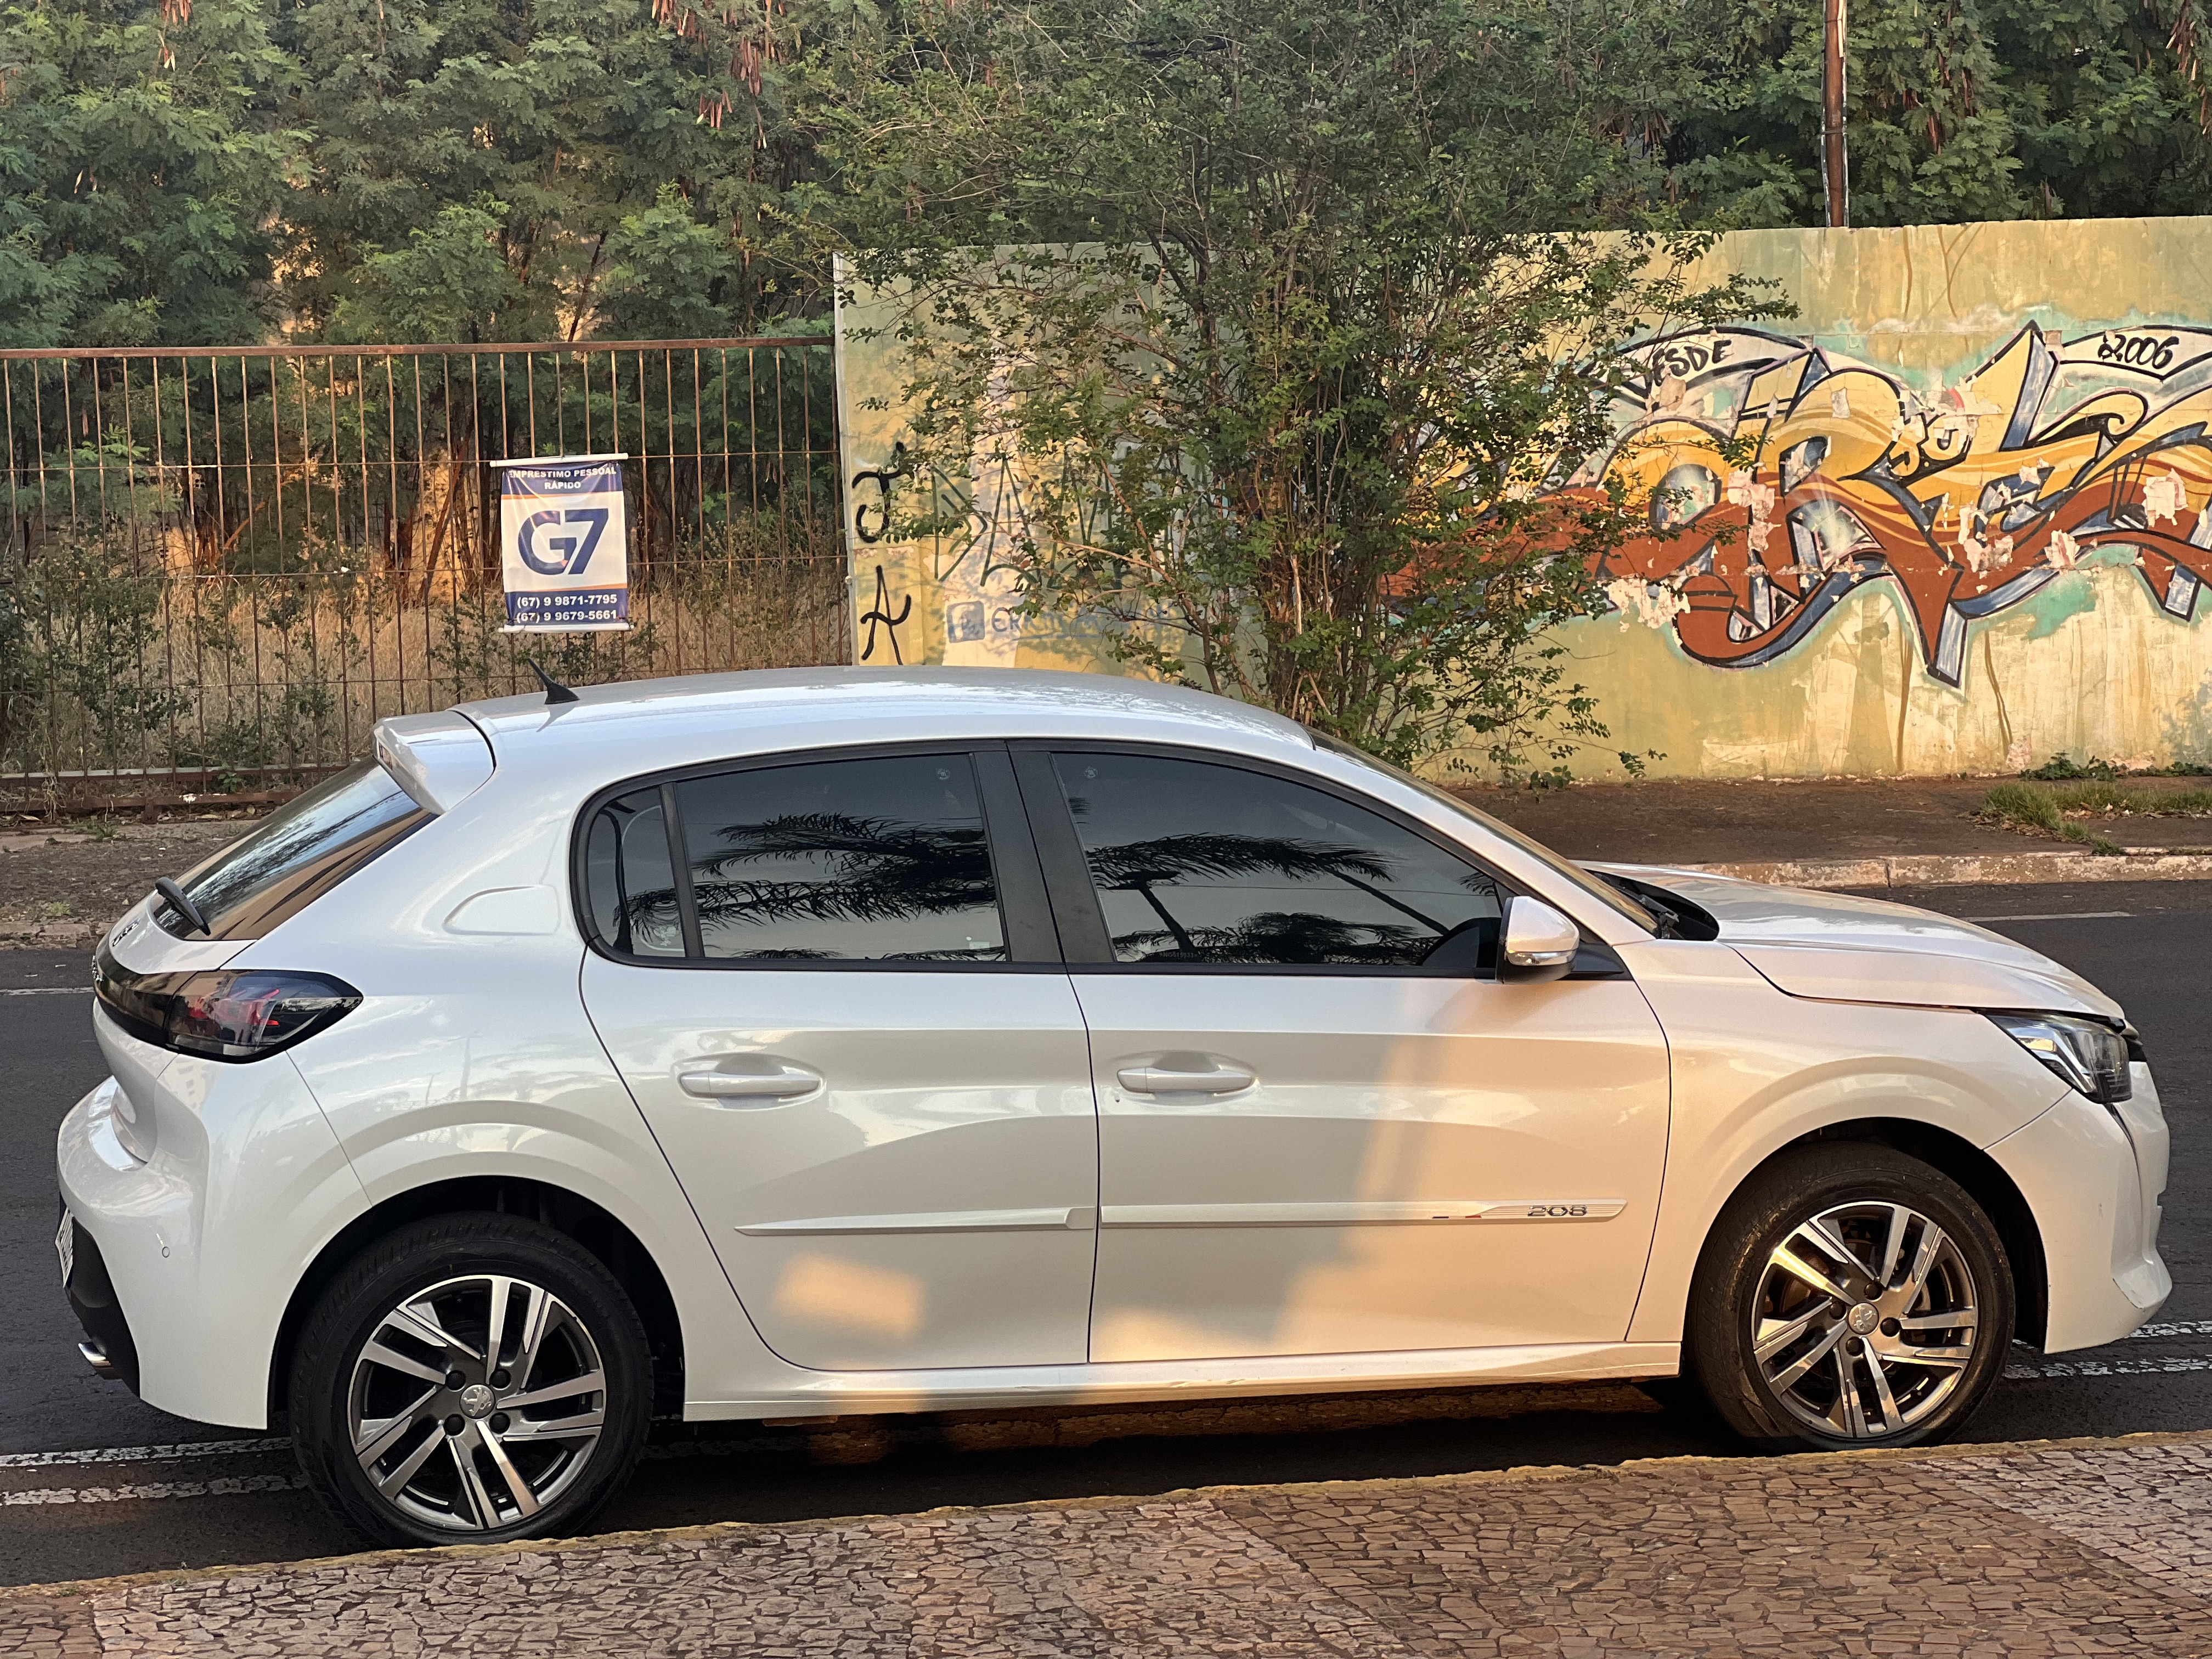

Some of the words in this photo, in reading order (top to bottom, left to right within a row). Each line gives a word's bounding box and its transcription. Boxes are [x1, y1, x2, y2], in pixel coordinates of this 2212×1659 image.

[574, 467, 617, 477] PESSOAL
[544, 481, 582, 489] RÁPIDO
[518, 508, 609, 575] G7
[517, 597, 540, 608] (67)
[543, 597, 551, 606] 9
[555, 594, 618, 605] 9871-7795
[516, 612, 540, 624] (67)
[543, 612, 551, 621] 9
[555, 610, 617, 620] 9679-5661
[1527, 1205, 1588, 1216] 208
